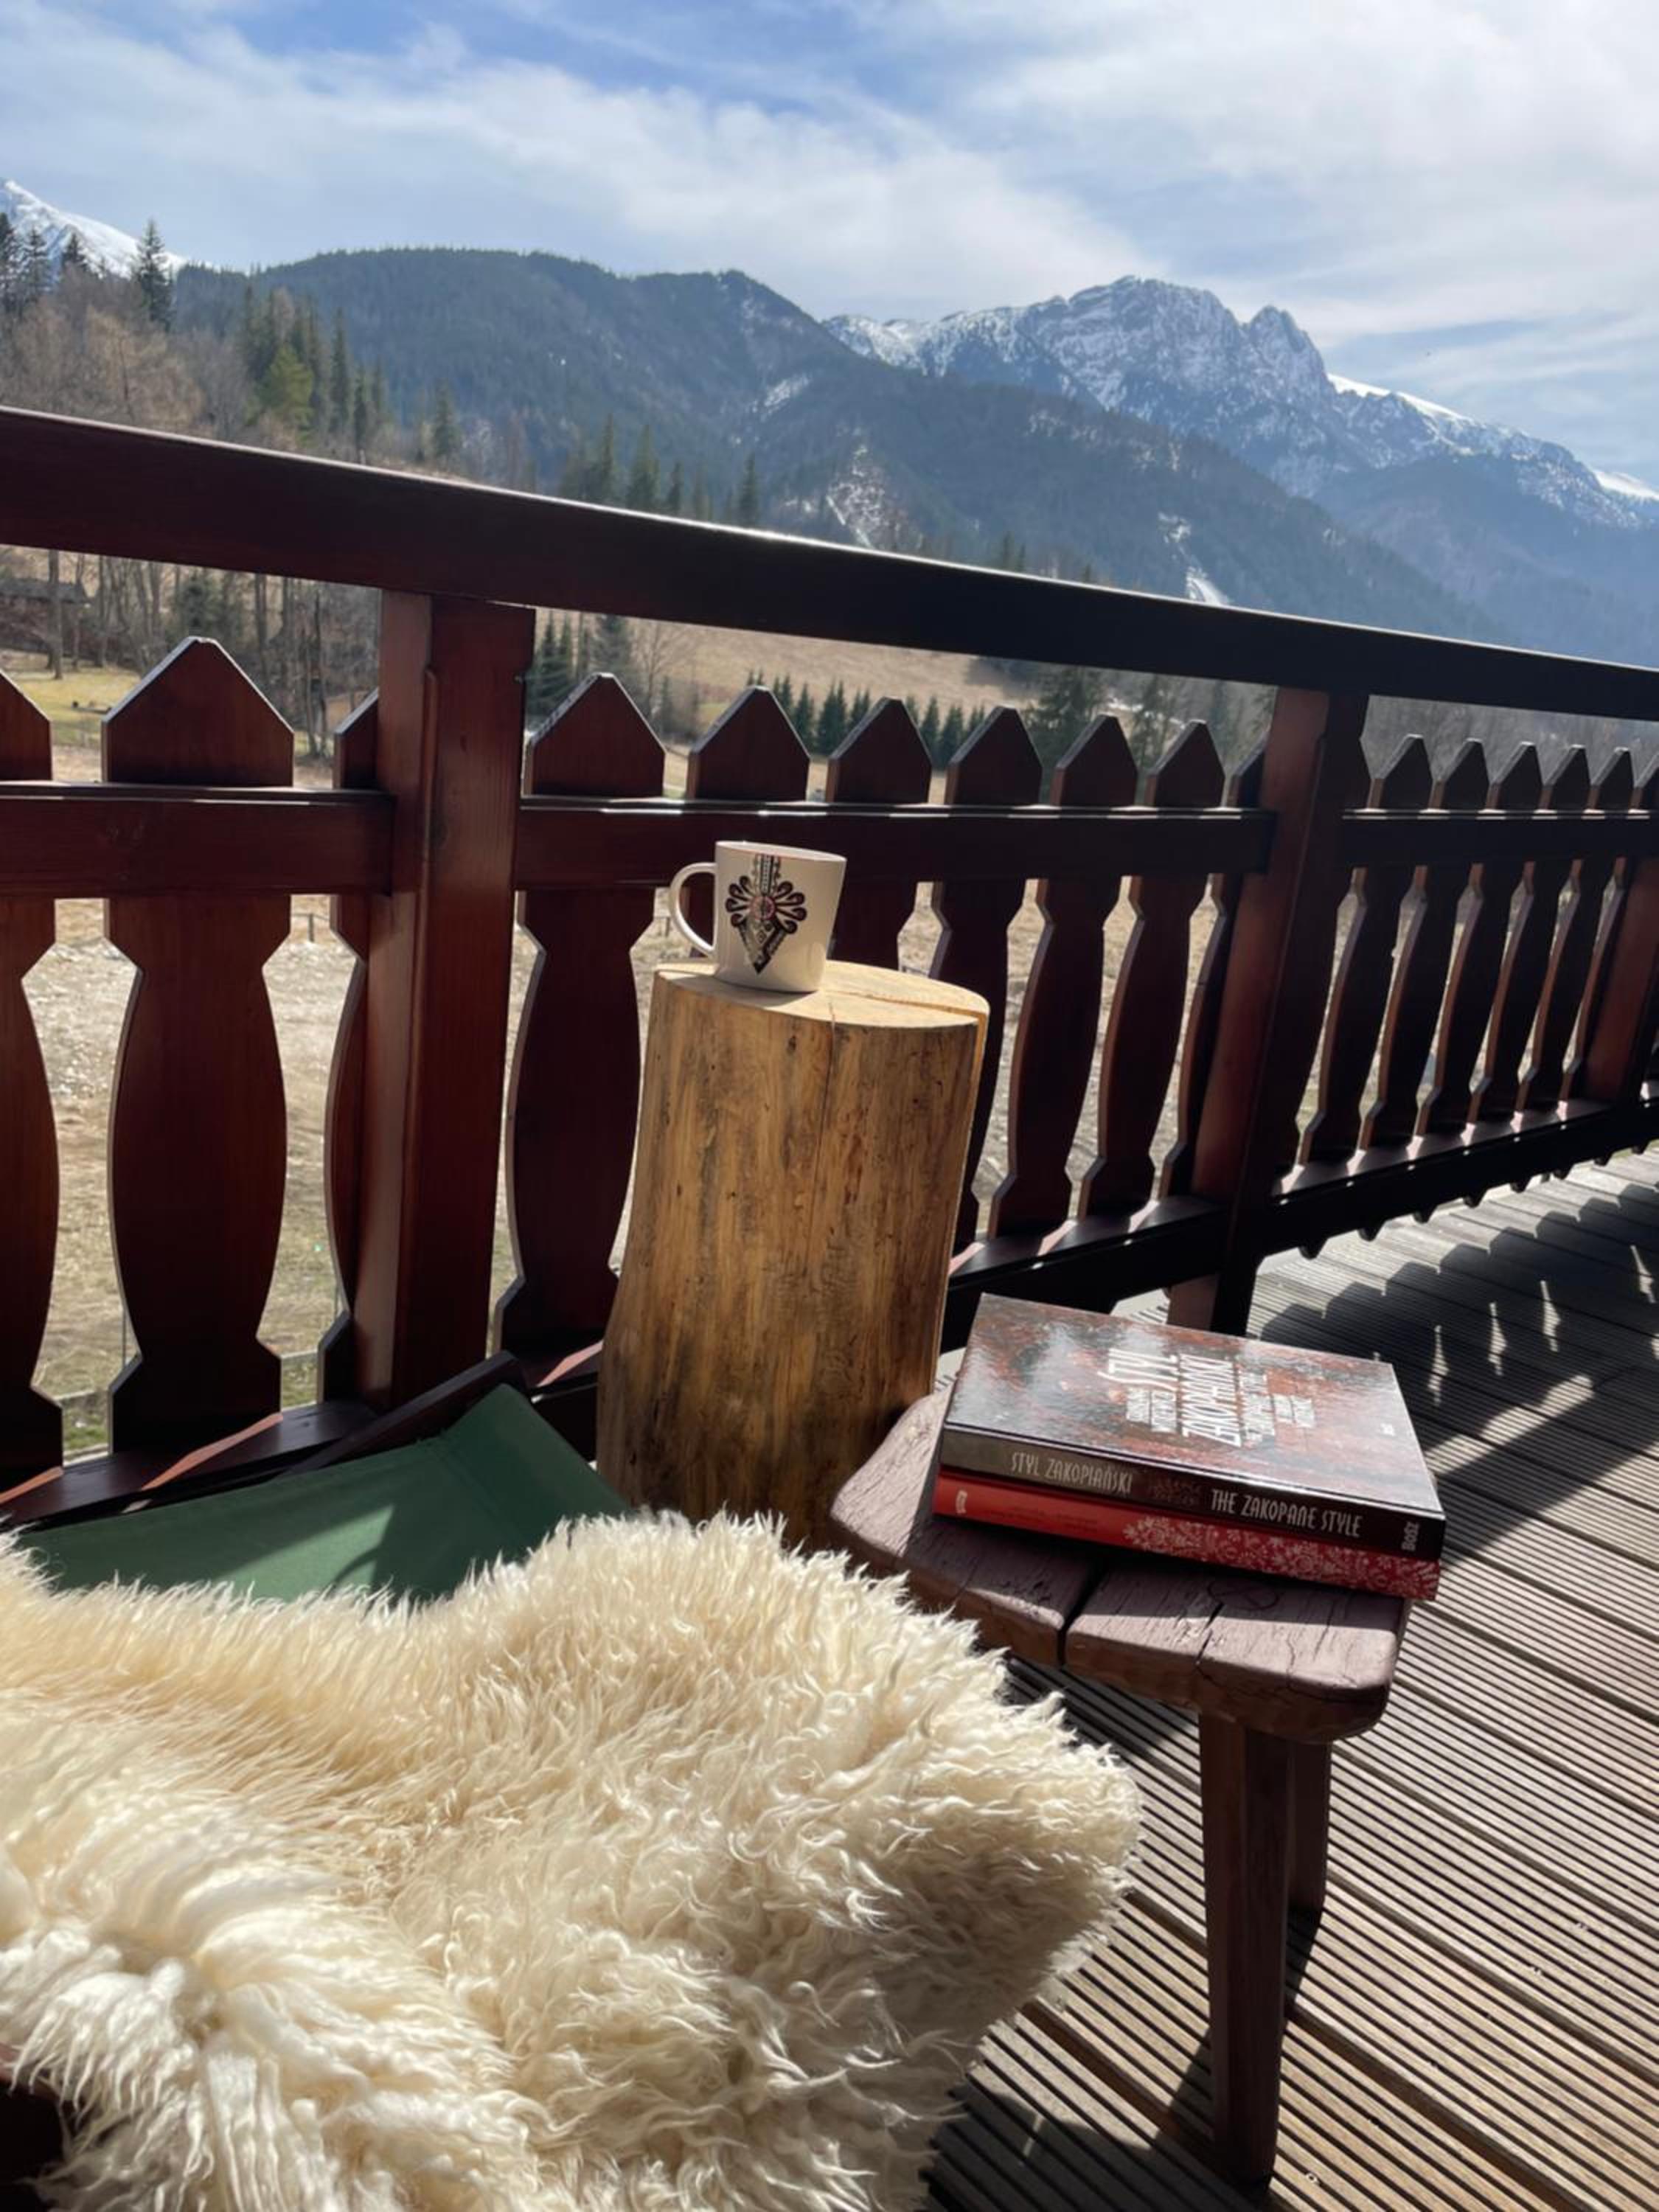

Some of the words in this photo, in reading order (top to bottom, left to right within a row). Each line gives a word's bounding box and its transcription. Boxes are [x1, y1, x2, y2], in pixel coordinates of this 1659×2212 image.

[1098, 1348, 1179, 1391] STYL
[1011, 1451, 1040, 1476] STYL
[1044, 1457, 1133, 1495] ZAKOPIAŃSKI
[1211, 1488, 1238, 1512] THE
[1240, 1494, 1318, 1530] ZAKOPANE
[1320, 1509, 1363, 1539] STYLE
